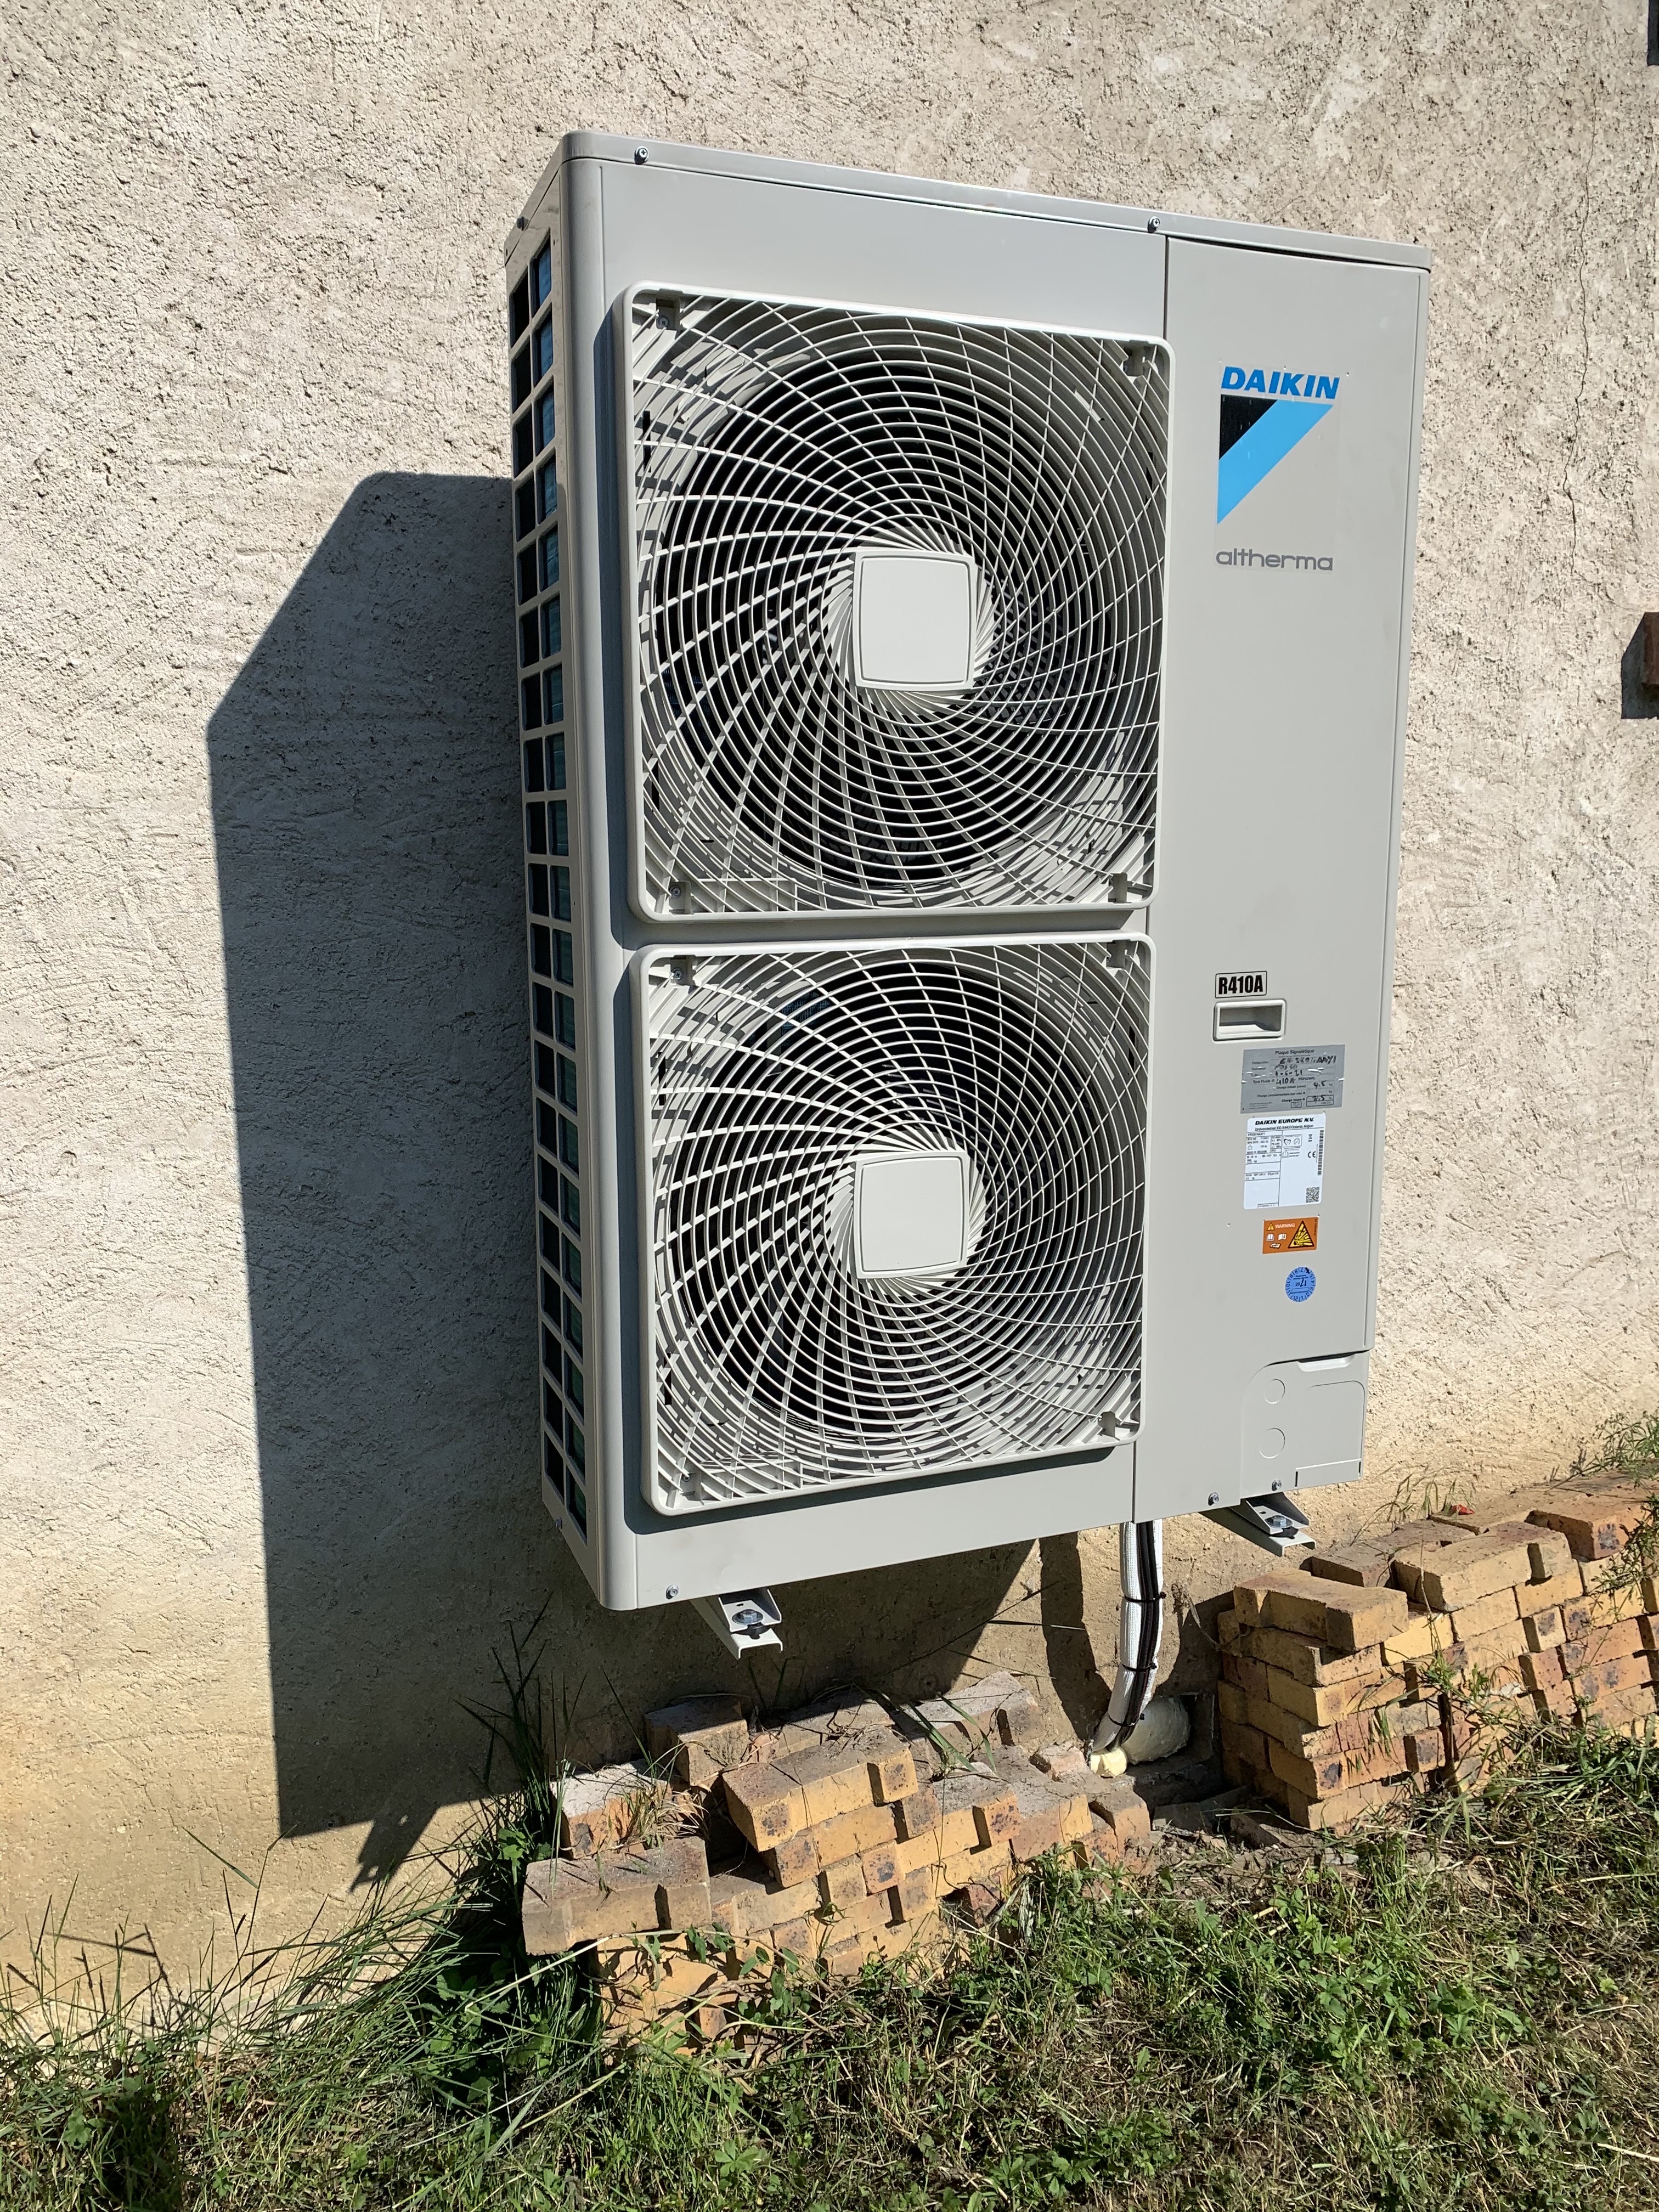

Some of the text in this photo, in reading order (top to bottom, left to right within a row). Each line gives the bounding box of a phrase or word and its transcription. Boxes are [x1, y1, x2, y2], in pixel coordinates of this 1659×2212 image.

[1221, 366, 1340, 399] DAIKIN
[1216, 548, 1333, 571] altherma
[1218, 975, 1263, 995] R410A
